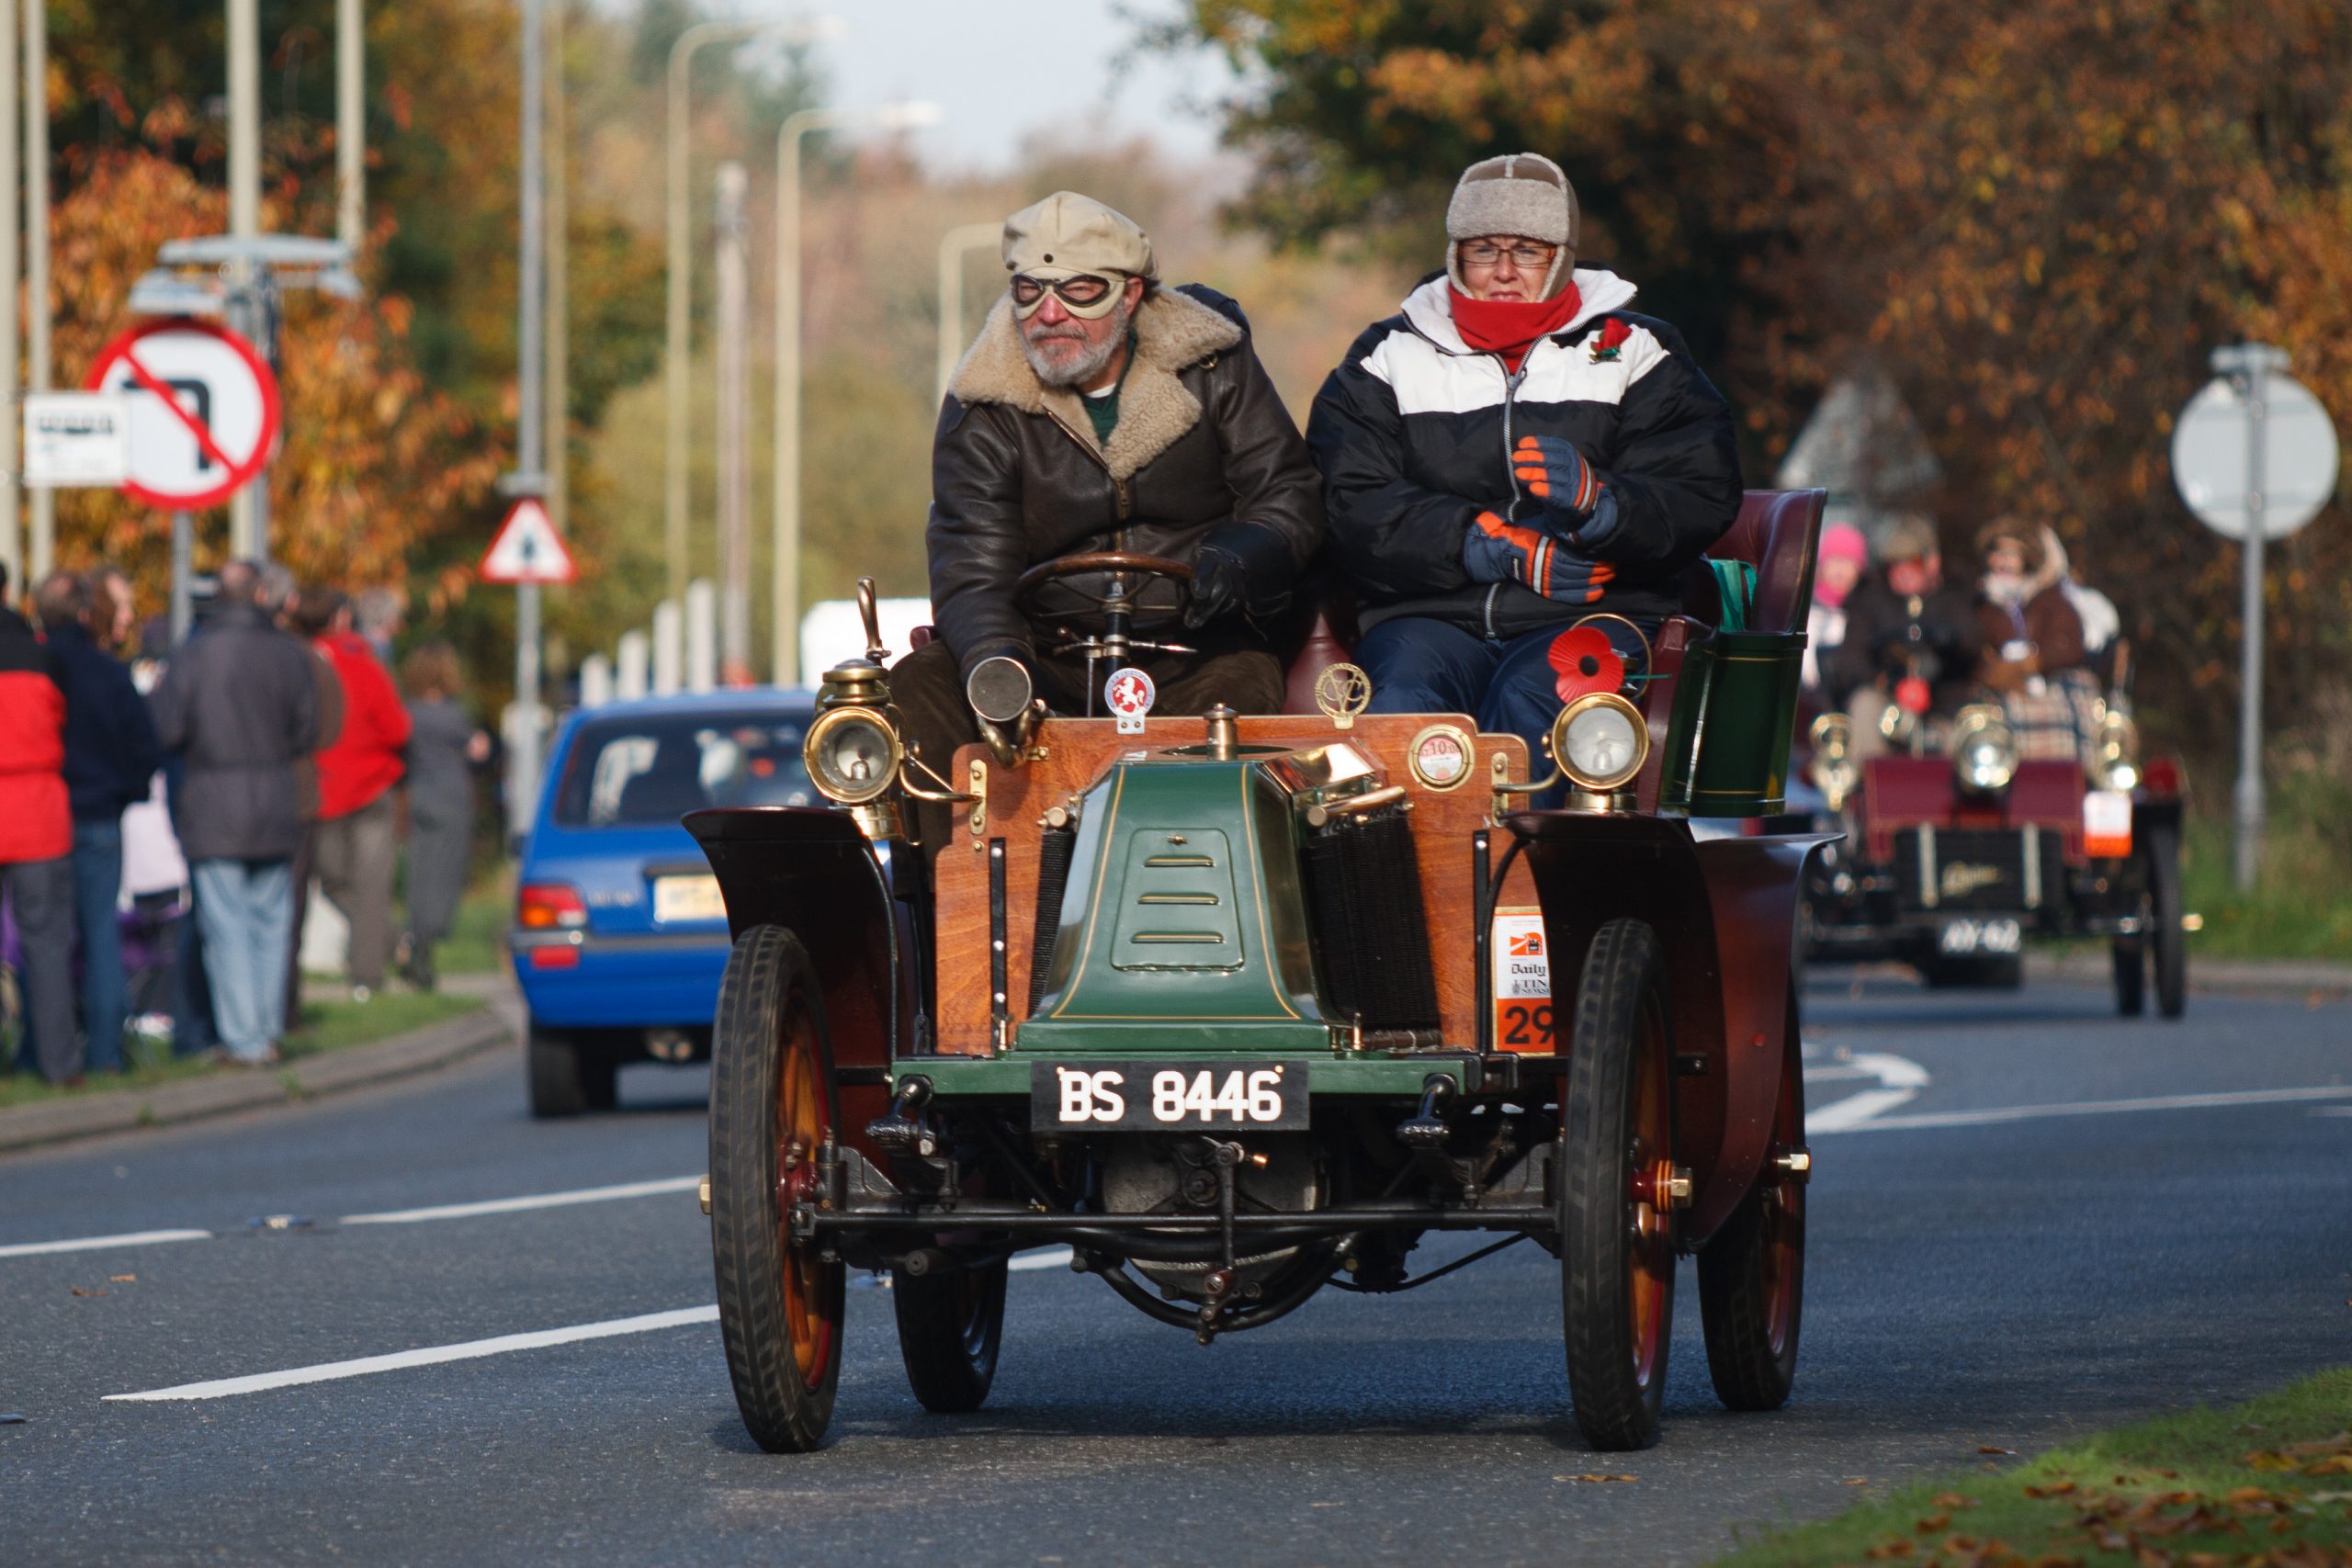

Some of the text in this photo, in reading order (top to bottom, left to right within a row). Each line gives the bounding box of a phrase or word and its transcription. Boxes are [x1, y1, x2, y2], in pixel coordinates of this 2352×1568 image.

[1511, 964, 1546, 976] Daily
[1505, 1006, 1555, 1044] 29
[1059, 1070, 1281, 1122] BS 8446
